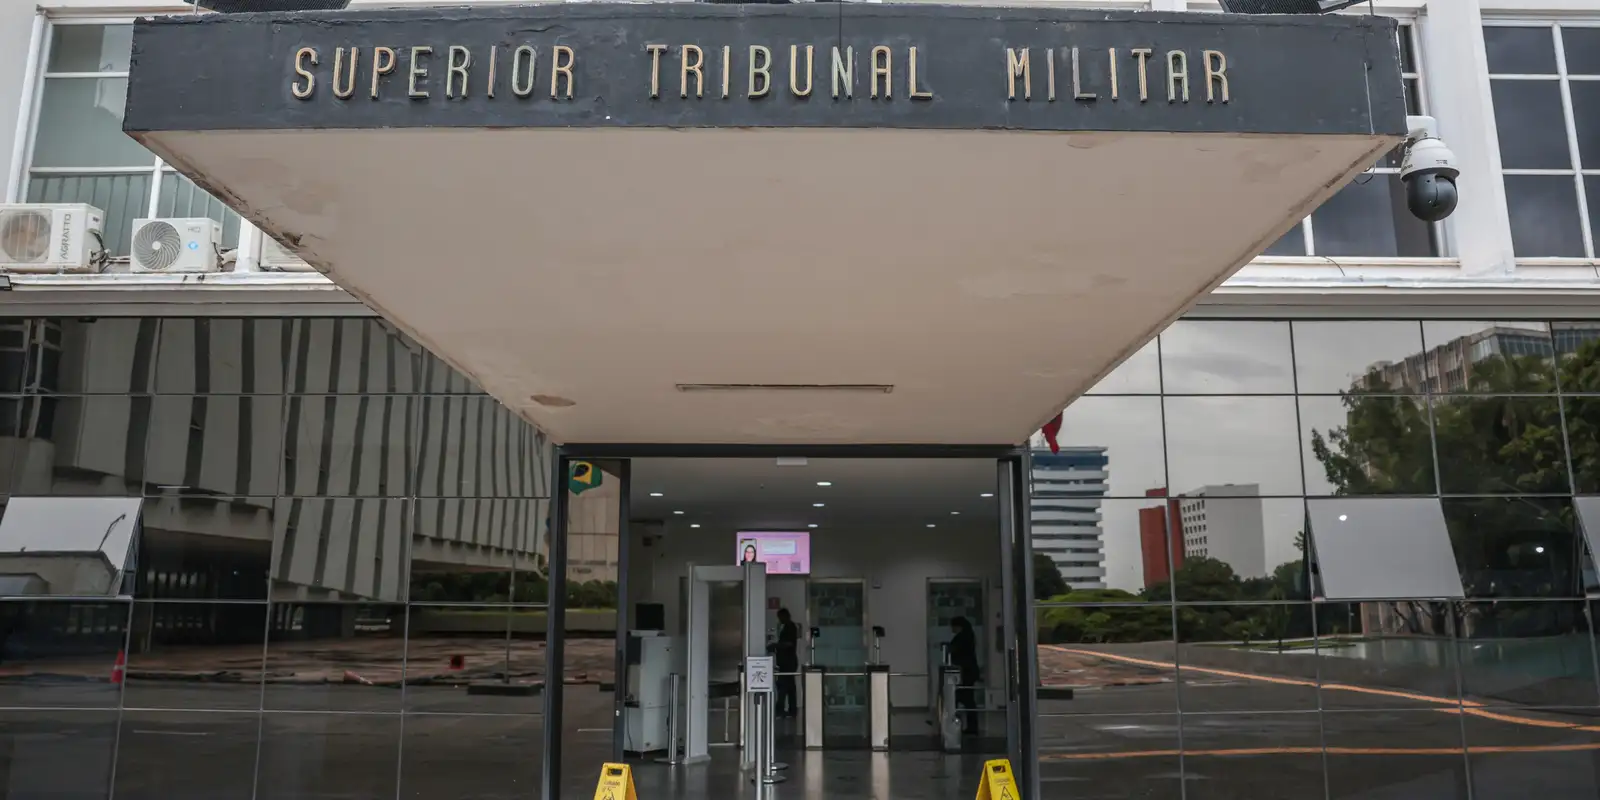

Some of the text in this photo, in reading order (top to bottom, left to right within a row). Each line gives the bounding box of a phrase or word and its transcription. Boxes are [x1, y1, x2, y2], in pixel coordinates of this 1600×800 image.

[291, 43, 1231, 104] SUPERIOR TRIBUNAL MILITAR
[60, 213, 71, 260] AGRATTO
